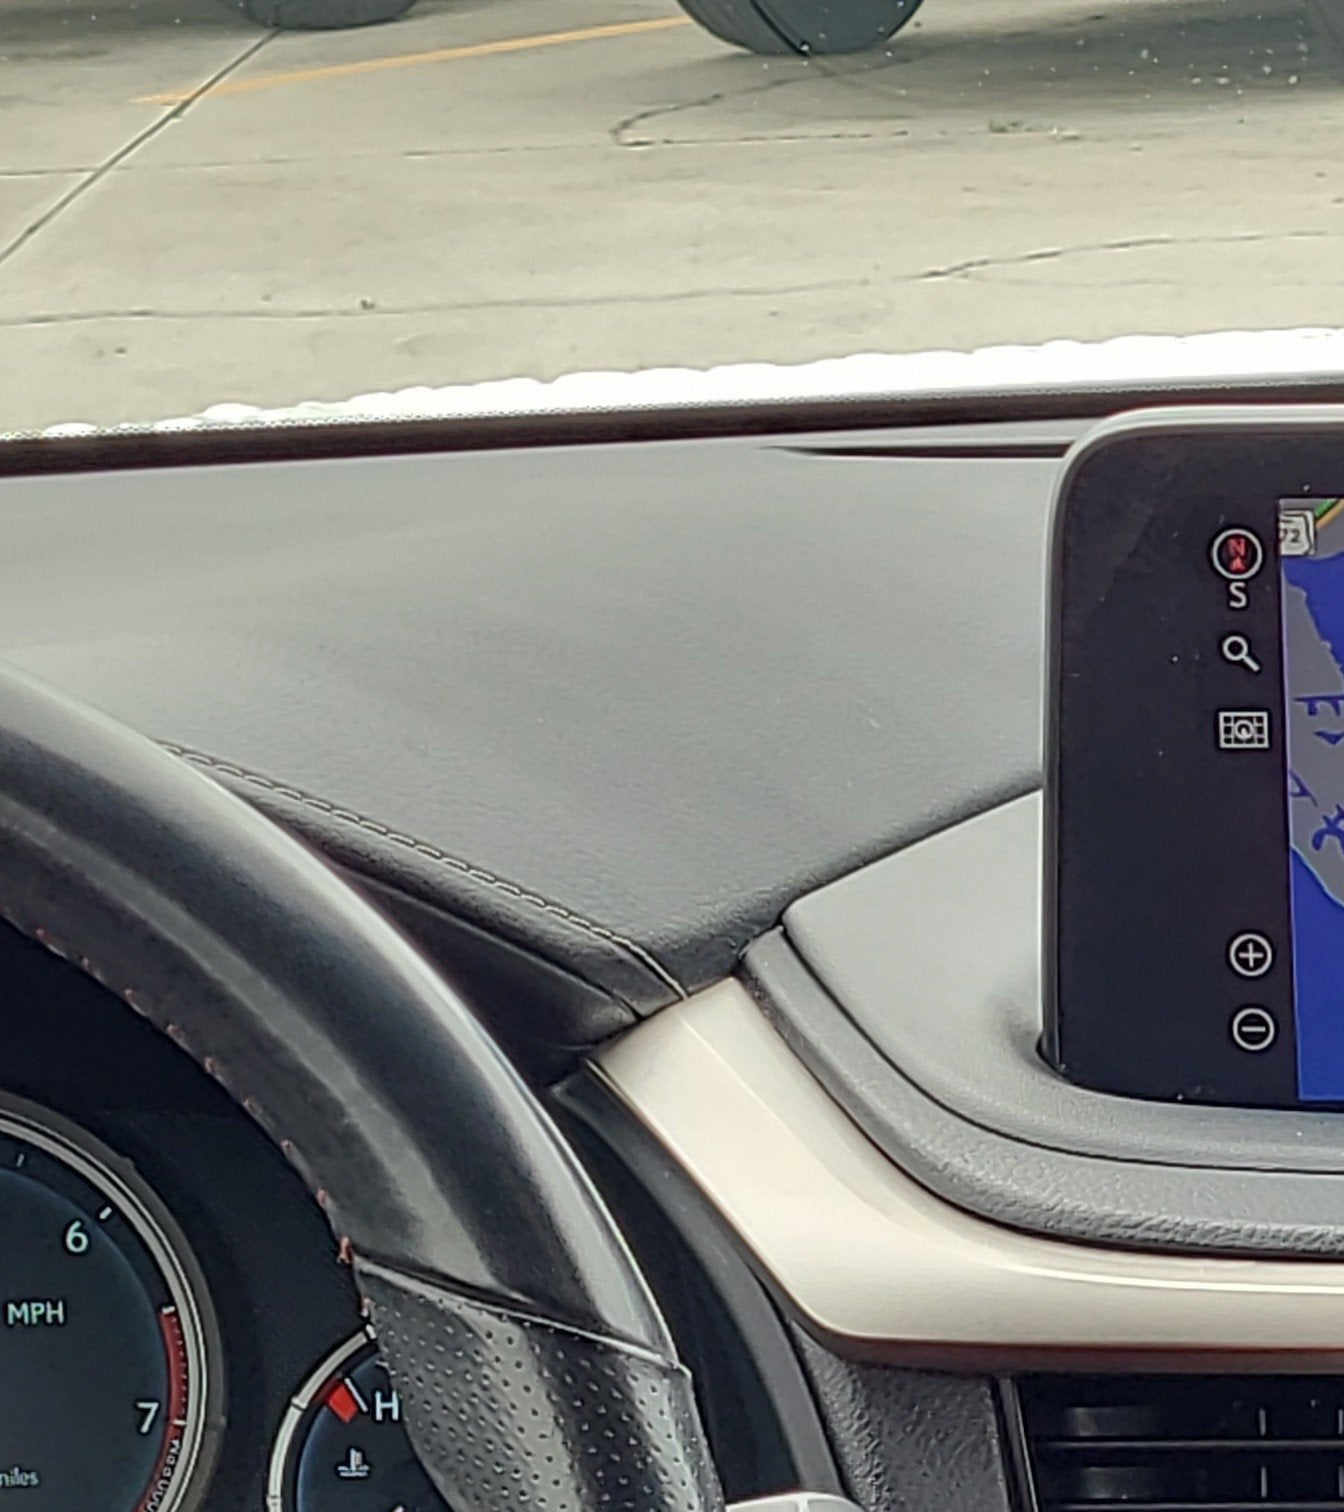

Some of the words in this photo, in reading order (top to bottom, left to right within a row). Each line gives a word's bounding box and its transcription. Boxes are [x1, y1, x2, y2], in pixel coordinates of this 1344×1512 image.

[1229, 581, 1247, 608] S
[65, 1220, 89, 1253] 6
[7, 1300, 64, 1325] MPH
[137, 1401, 159, 1433] 7
[374, 1390, 399, 1421] H
